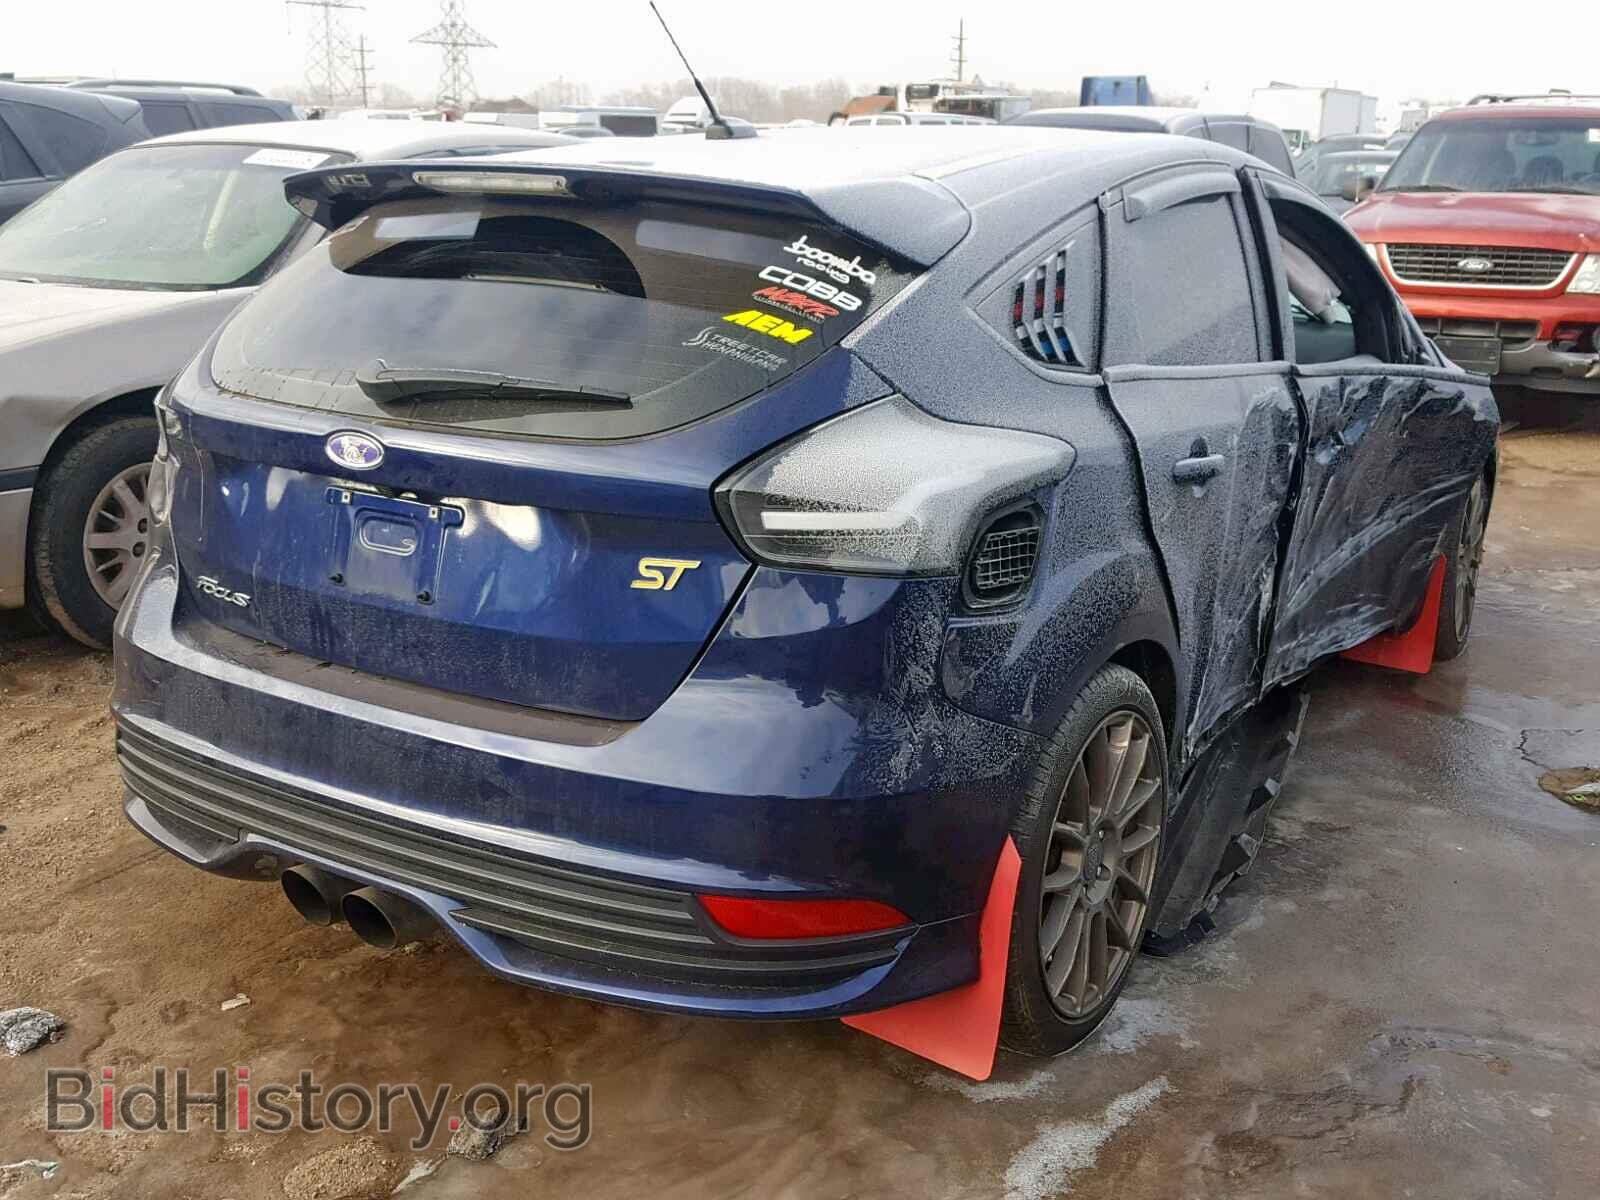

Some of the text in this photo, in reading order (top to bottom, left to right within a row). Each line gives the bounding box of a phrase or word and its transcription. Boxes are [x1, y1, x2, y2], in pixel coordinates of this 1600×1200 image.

[783, 234, 876, 285] boomba
[758, 265, 862, 311] COBB
[722, 310, 814, 344] AEM
[629, 557, 702, 591] ST
